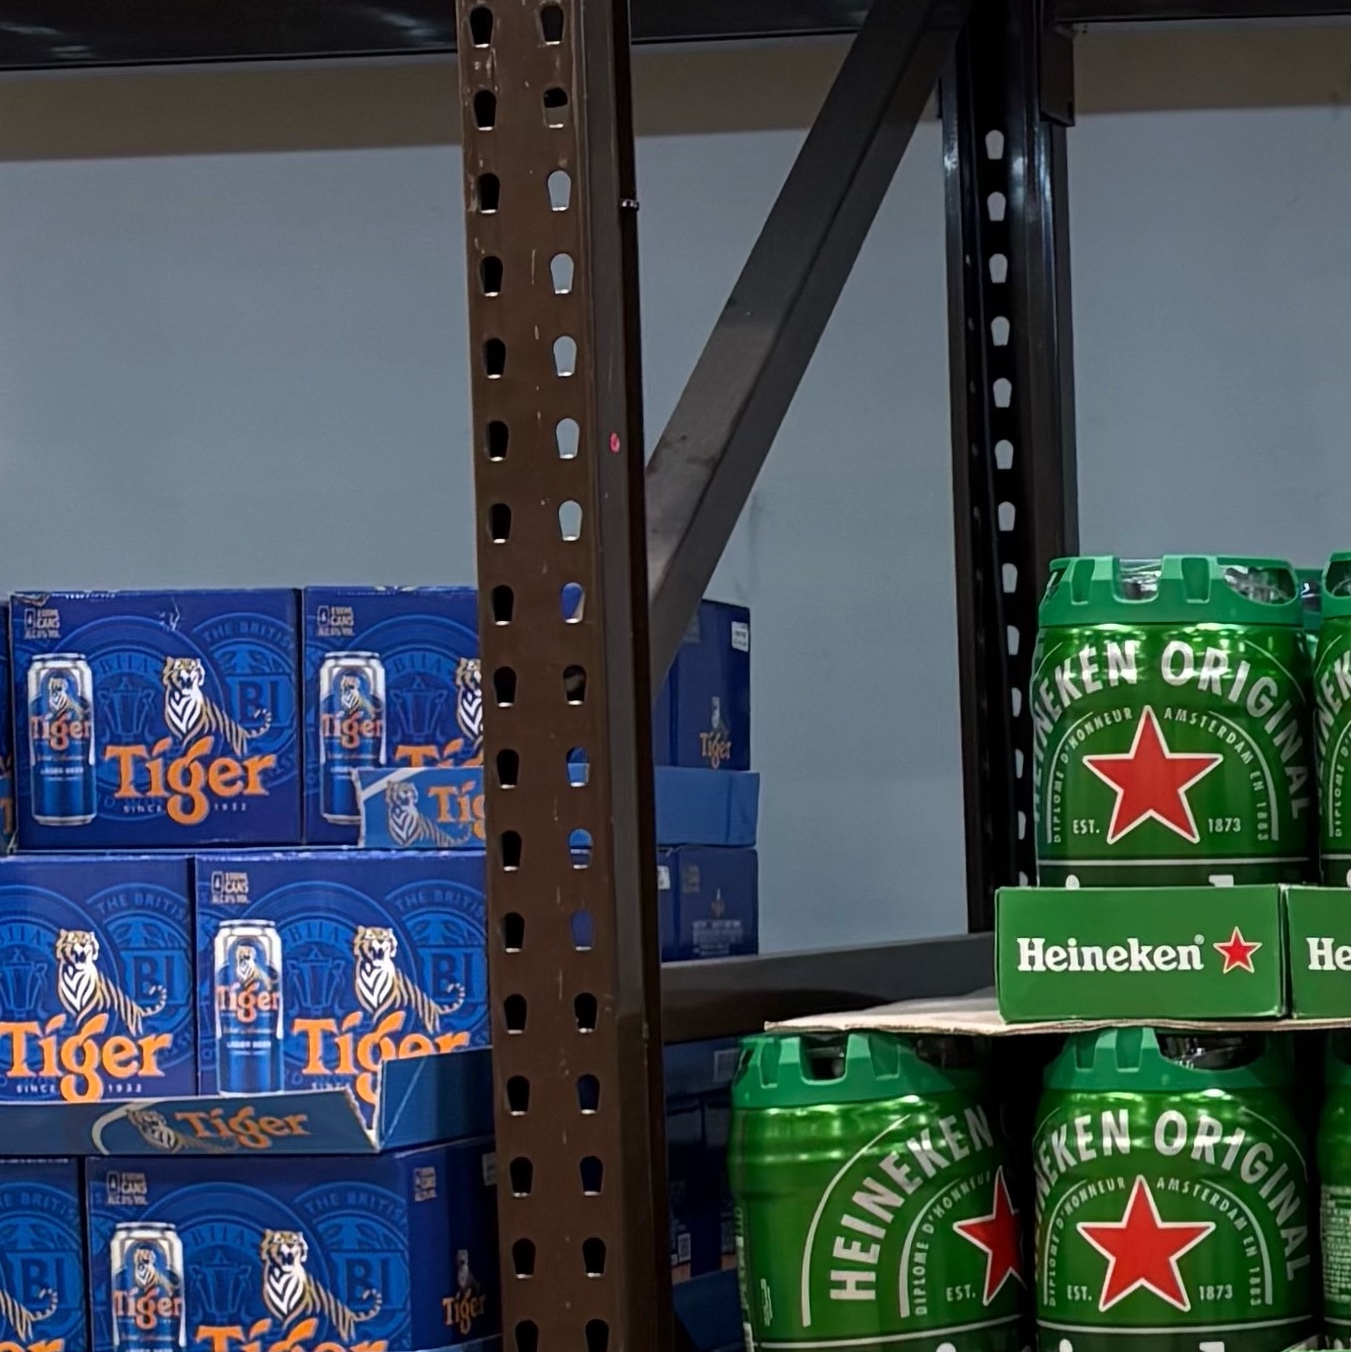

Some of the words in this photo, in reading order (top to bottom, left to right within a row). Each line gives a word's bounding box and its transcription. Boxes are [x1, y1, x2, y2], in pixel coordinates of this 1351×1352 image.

[31, 711, 92, 750] Tiger
[322, 711, 382, 748] Tiger
[1161, 641, 1310, 819] ORIGINAL
[105, 736, 276, 825] Tiger
[1073, 819, 1100, 834] EST.
[1208, 817, 1241, 833] 1873
[1017, 937, 1204, 972] Heineken
[216, 983, 279, 1022] Tiger
[0, 1012, 172, 1102] Tiger
[16, 1084, 58, 1093] SINCE
[174, 1105, 311, 1149] Tiger
[830, 1104, 994, 1302] HEINEKEN
[1154, 1111, 1310, 1281] ORIGINAL
[1157, 1177, 1247, 1229] AMSTERDAM
[112, 1288, 183, 1332] Tiger
[946, 1286, 976, 1302] EST.
[1067, 1286, 1092, 1301] EST.
[1199, 1285, 1233, 1301] 1873
[442, 1294, 485, 1334] Tiger
